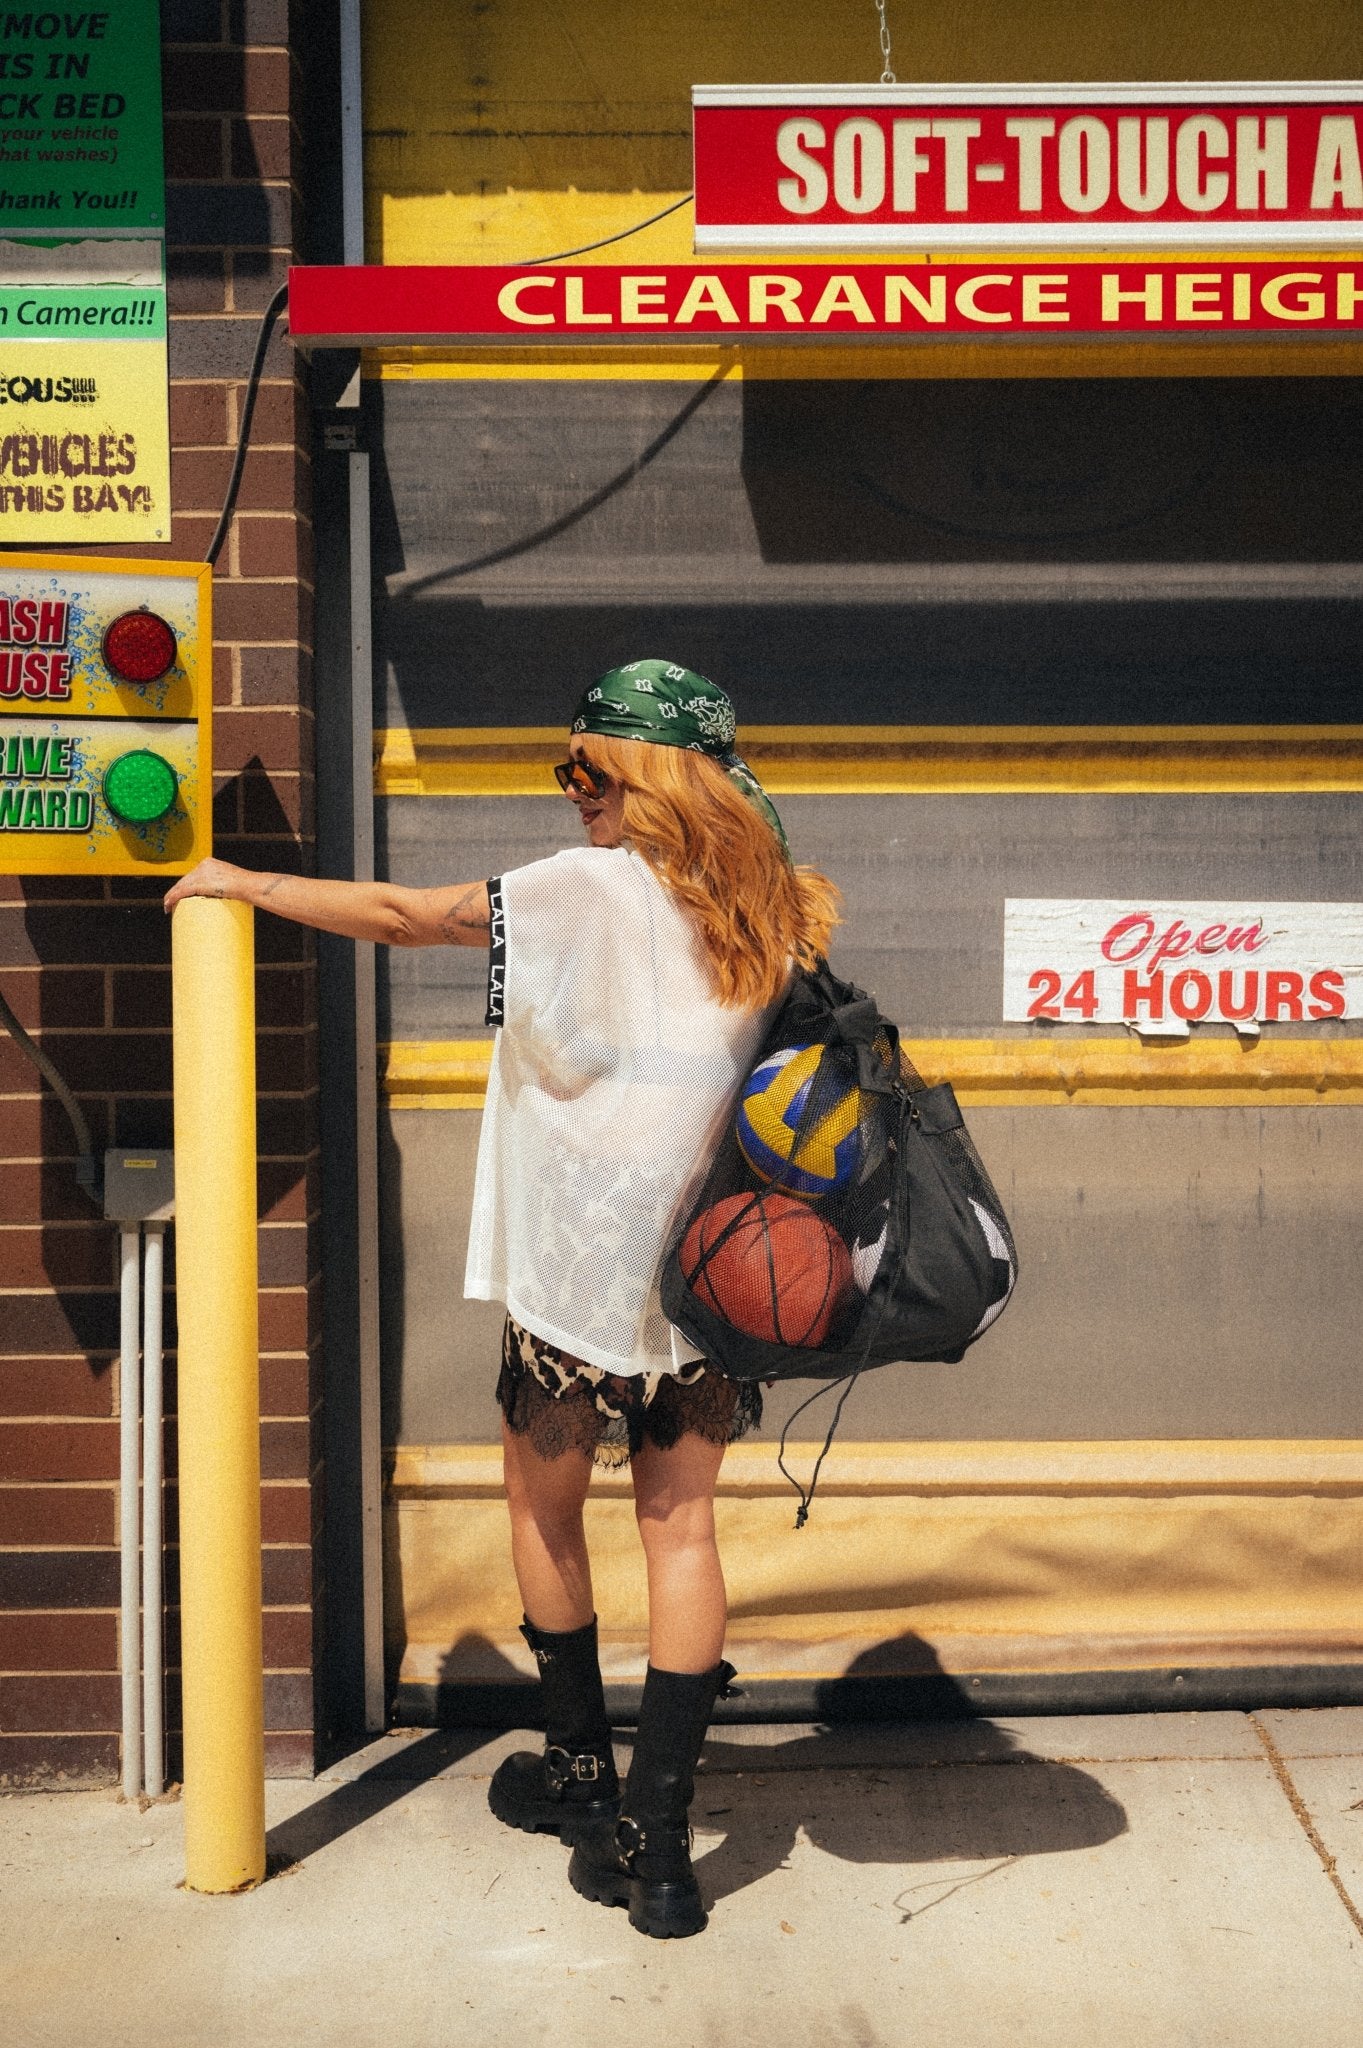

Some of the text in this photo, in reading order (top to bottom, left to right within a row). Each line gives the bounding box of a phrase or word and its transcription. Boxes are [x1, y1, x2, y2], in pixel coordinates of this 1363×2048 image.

[0, 12, 109, 40] MOVE
[44, 53, 90, 80] IN
[53, 93, 126, 120] BED
[51, 125, 119, 141] vehicle
[37, 145, 118, 165] washes)
[776, 114, 1288, 215] SOFT-TOUCH
[72, 190, 138, 209] You!!
[17, 300, 155, 325] Camera!!!
[497, 274, 1071, 325] CLEARANCE
[73, 484, 151, 513] BAY!
[0, 735, 72, 777] IVE
[490, 892, 504, 949] LALA
[1100, 911, 1269, 975] Open
[489, 965, 504, 1016] LALA
[1026, 969, 1347, 1020] 24 HOURS
